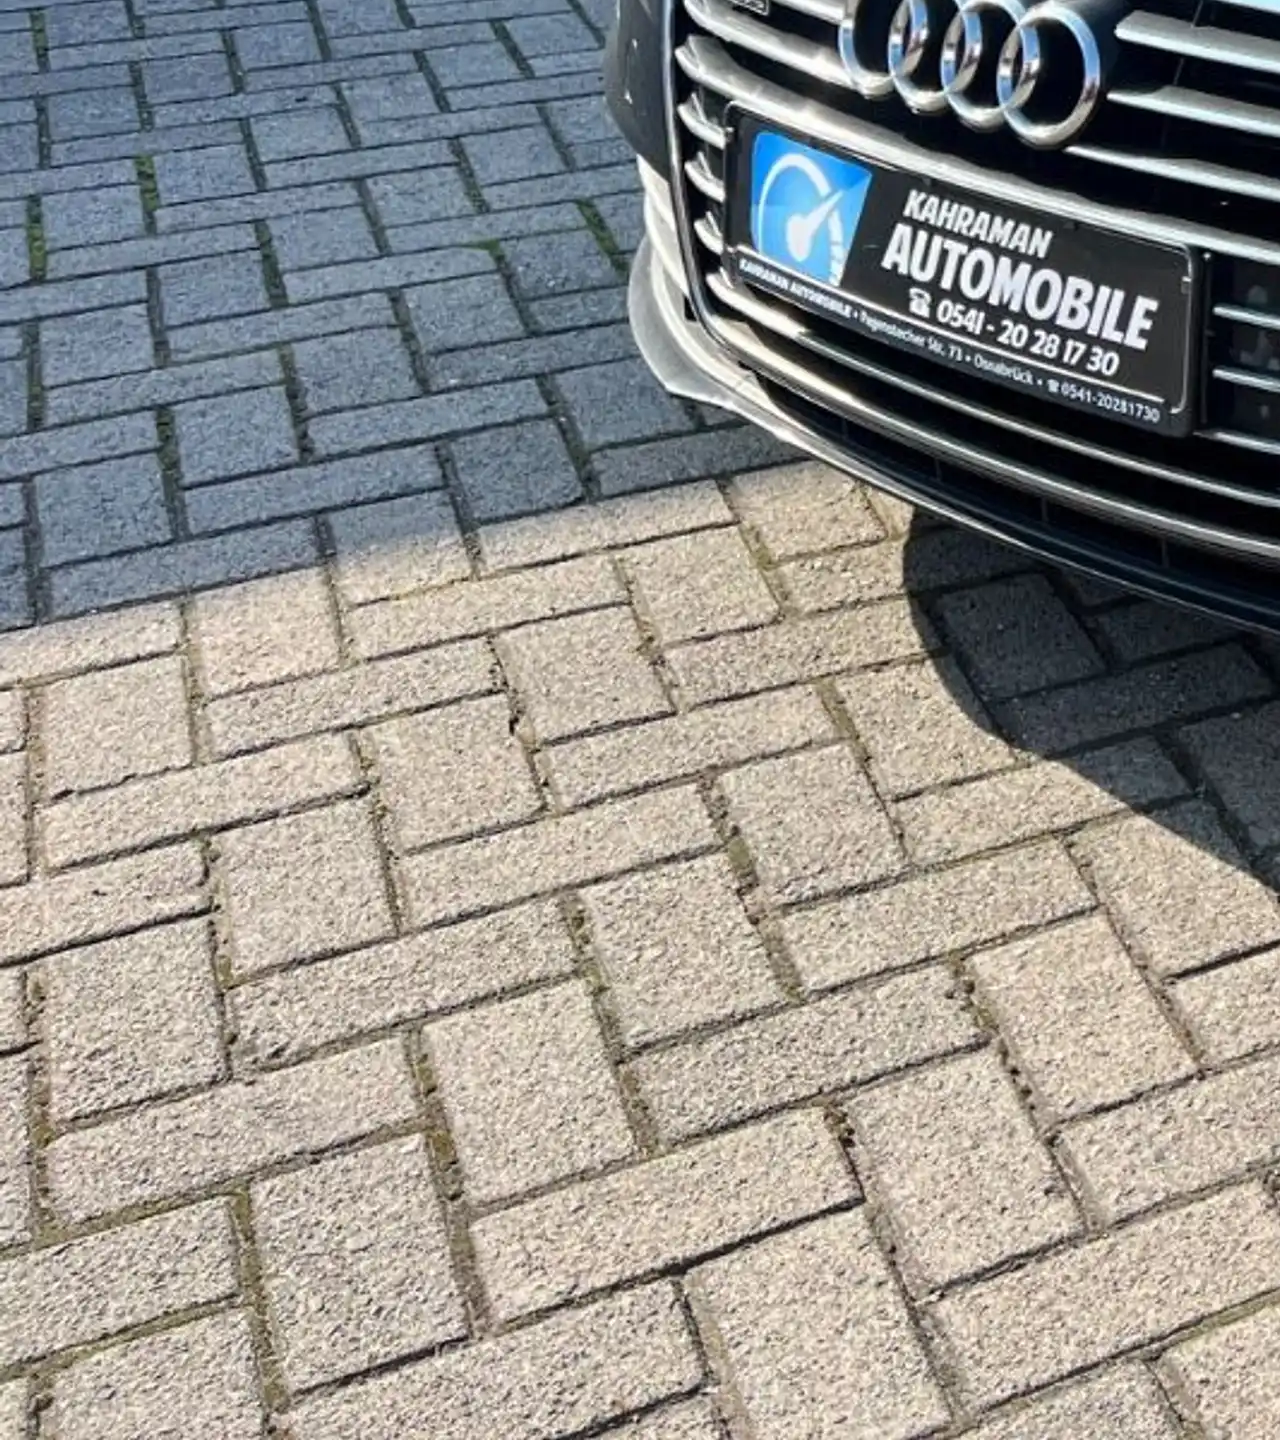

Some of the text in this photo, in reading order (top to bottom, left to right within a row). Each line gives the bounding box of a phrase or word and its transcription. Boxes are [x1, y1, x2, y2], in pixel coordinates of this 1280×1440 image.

[902, 189, 1054, 259] KAHRAMAN
[880, 222, 1160, 351] AUTOMOBILE
[936, 298, 986, 335] 0541
[996, 319, 1029, 348] 20
[1029, 329, 1061, 359] 28
[1062, 339, 1087, 366] 17
[1085, 347, 1121, 377] 30
[974, 354, 1034, 386] Osnabrück
[1060, 381, 1161, 423] 0541-20281730
